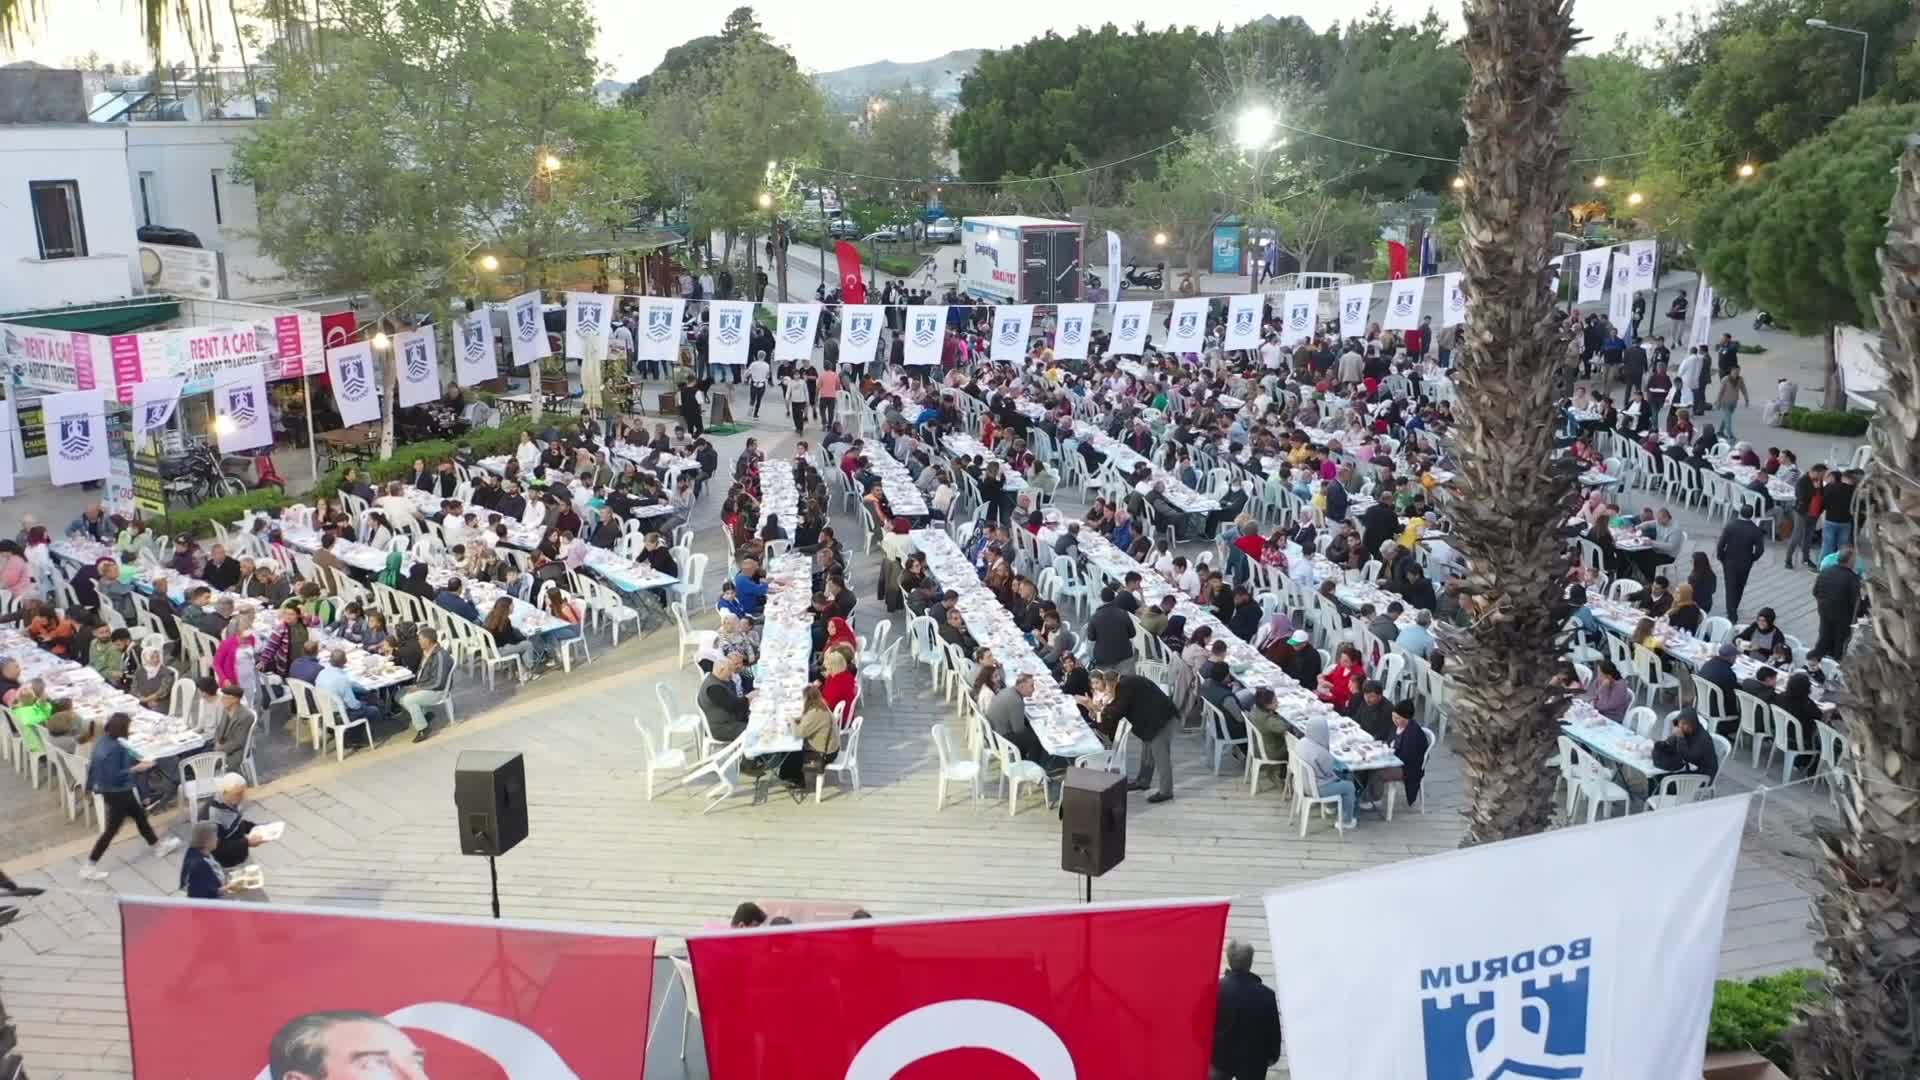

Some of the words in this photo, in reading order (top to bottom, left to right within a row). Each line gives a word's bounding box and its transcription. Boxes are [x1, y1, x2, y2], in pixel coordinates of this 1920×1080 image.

[190, 336, 218, 360] RENT
[223, 335, 231, 355] A
[232, 333, 255, 353] CAR
